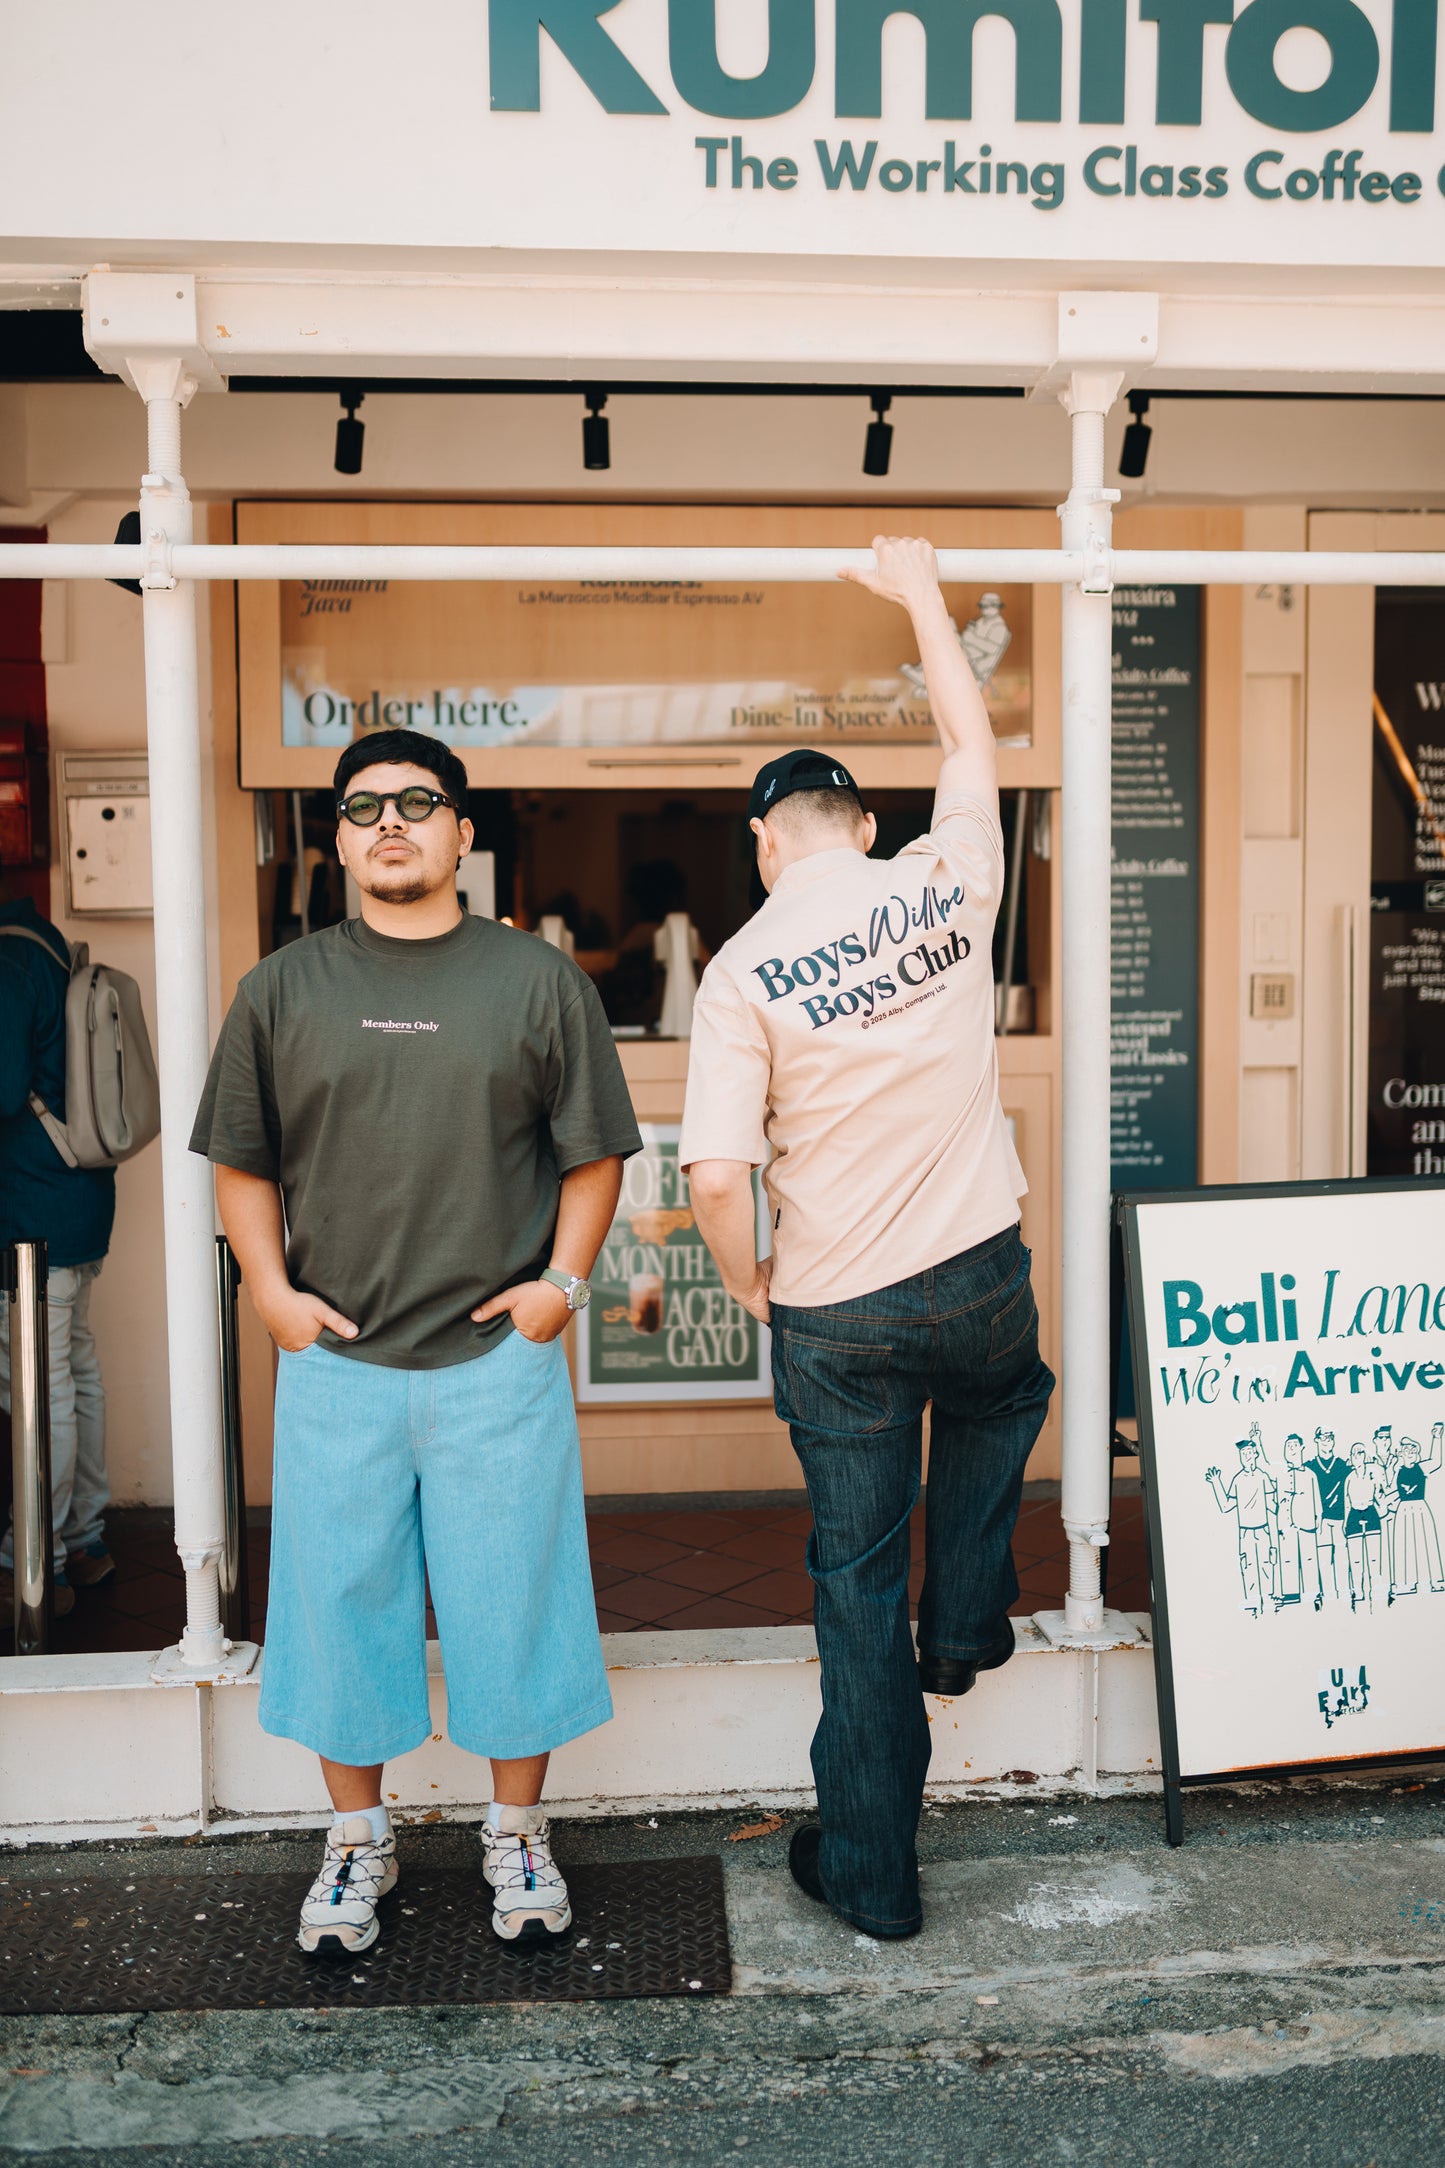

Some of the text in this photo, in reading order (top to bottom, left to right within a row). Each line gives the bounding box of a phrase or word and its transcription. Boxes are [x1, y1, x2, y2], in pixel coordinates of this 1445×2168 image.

[695, 137, 798, 190] The
[815, 140, 1066, 210] Working
[1083, 145, 1229, 198] Class
[1244, 150, 1422, 203] Coffee
[300, 593, 353, 617] Java
[303, 690, 529, 727] Order here.
[730, 706, 818, 728] Dine-In
[822, 706, 888, 731] Space
[751, 931, 868, 1003] Boys
[798, 930, 972, 1030] Boys Club
[870, 1012, 888, 1025] 2025
[904, 990, 935, 1009] Company
[934, 983, 948, 993] Ltd.
[361, 1019, 440, 1032] Members Only
[601, 1244, 706, 1283] MONTH
[664, 1287, 749, 1329] ACEH
[1162, 1272, 1299, 1348] Bali
[666, 1325, 749, 1368] GAYO
